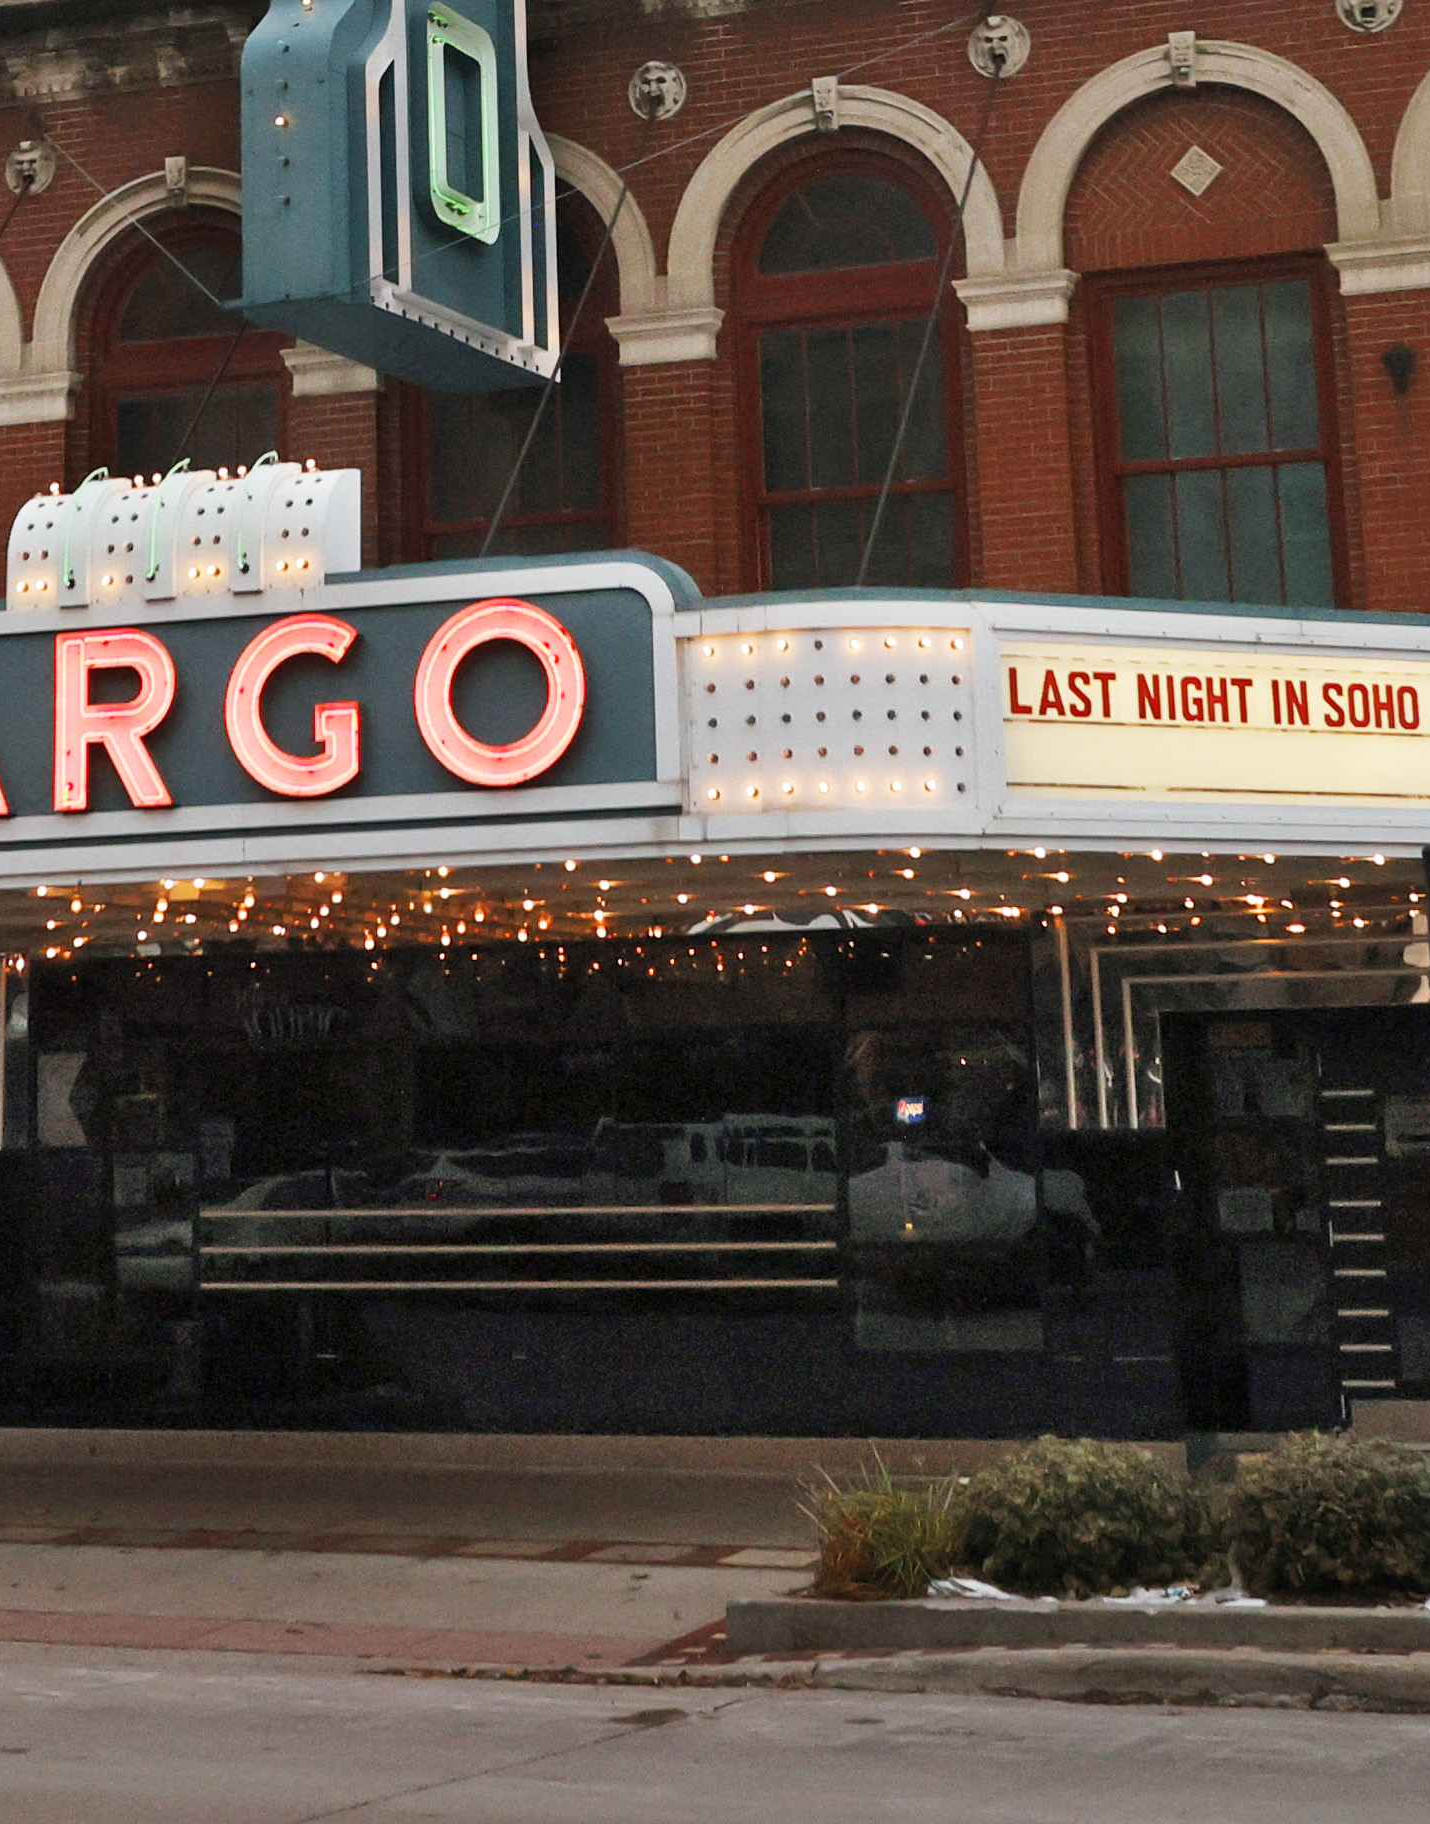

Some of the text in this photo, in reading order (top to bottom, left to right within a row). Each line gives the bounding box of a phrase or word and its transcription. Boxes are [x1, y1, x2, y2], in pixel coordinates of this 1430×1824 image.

[1008, 666, 1421, 730] LAST NIGHT IN SOHO
